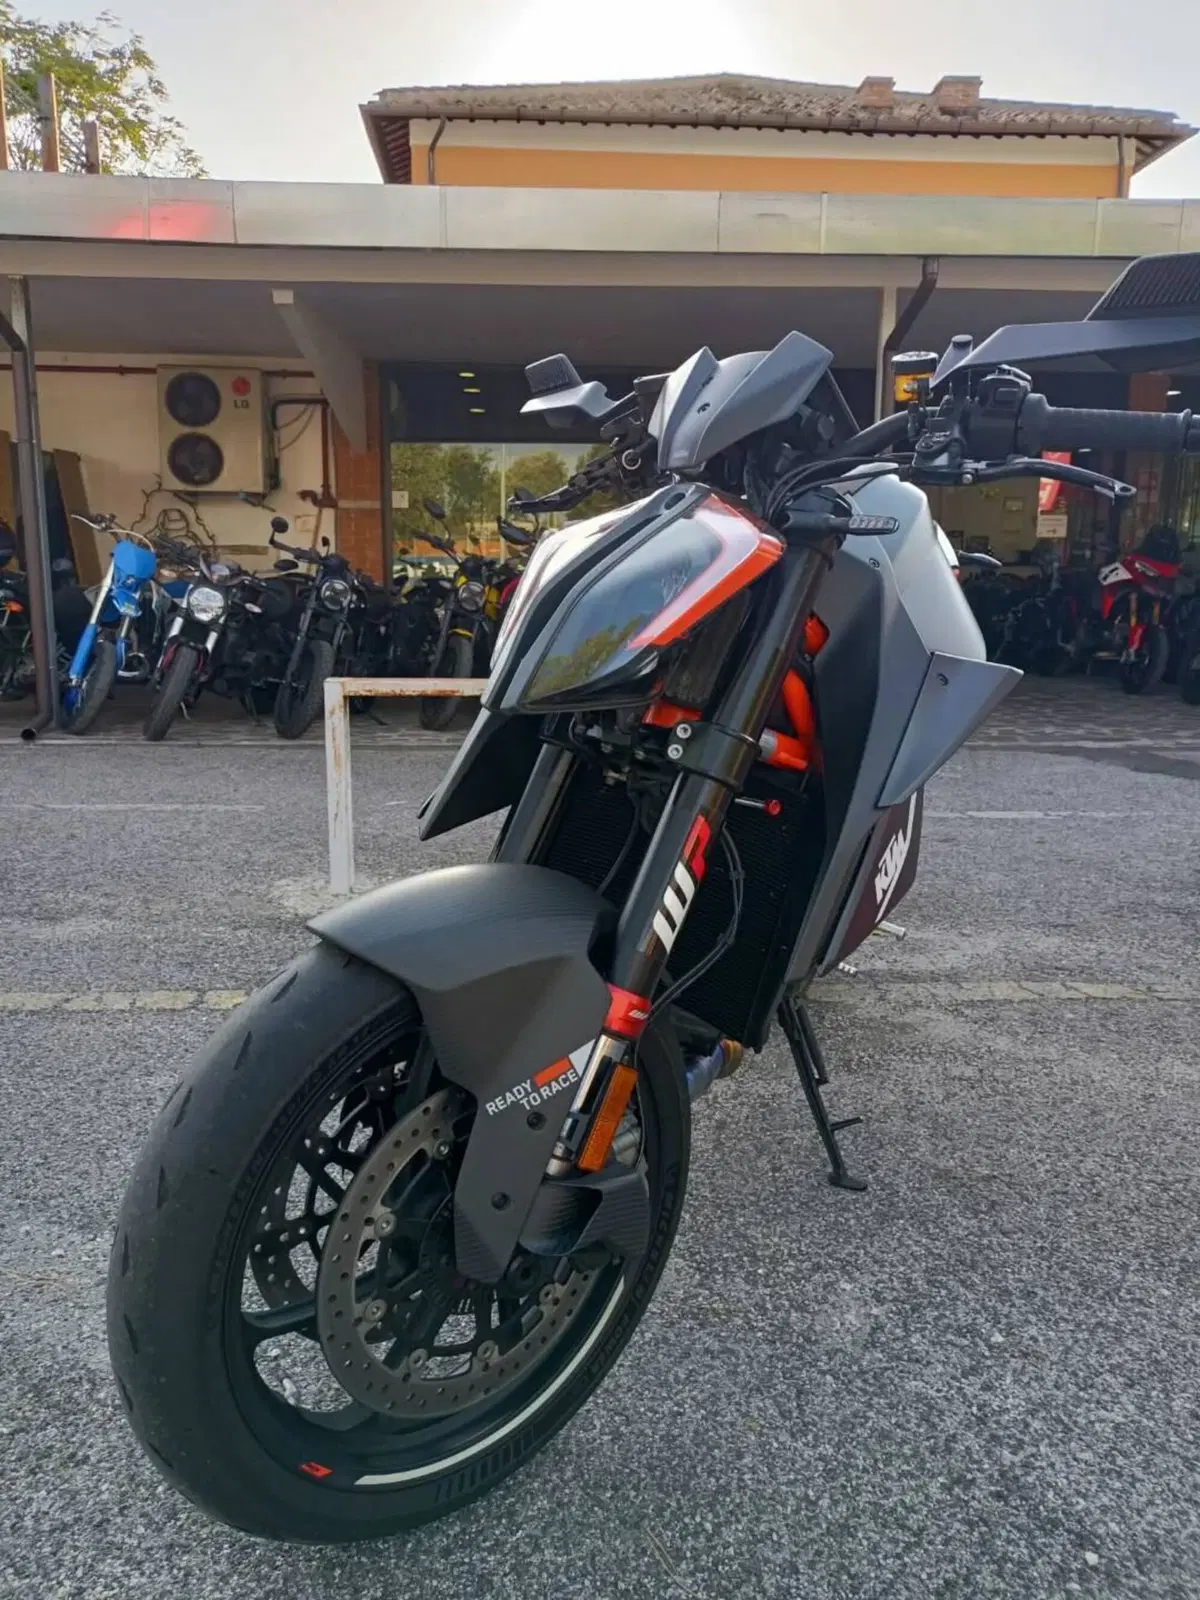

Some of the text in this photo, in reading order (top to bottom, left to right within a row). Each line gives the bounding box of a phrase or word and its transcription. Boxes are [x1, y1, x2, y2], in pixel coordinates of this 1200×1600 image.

[874, 828, 909, 905] KTM
[485, 1079, 532, 1116] READY
[519, 1068, 579, 1111] TO RACE
